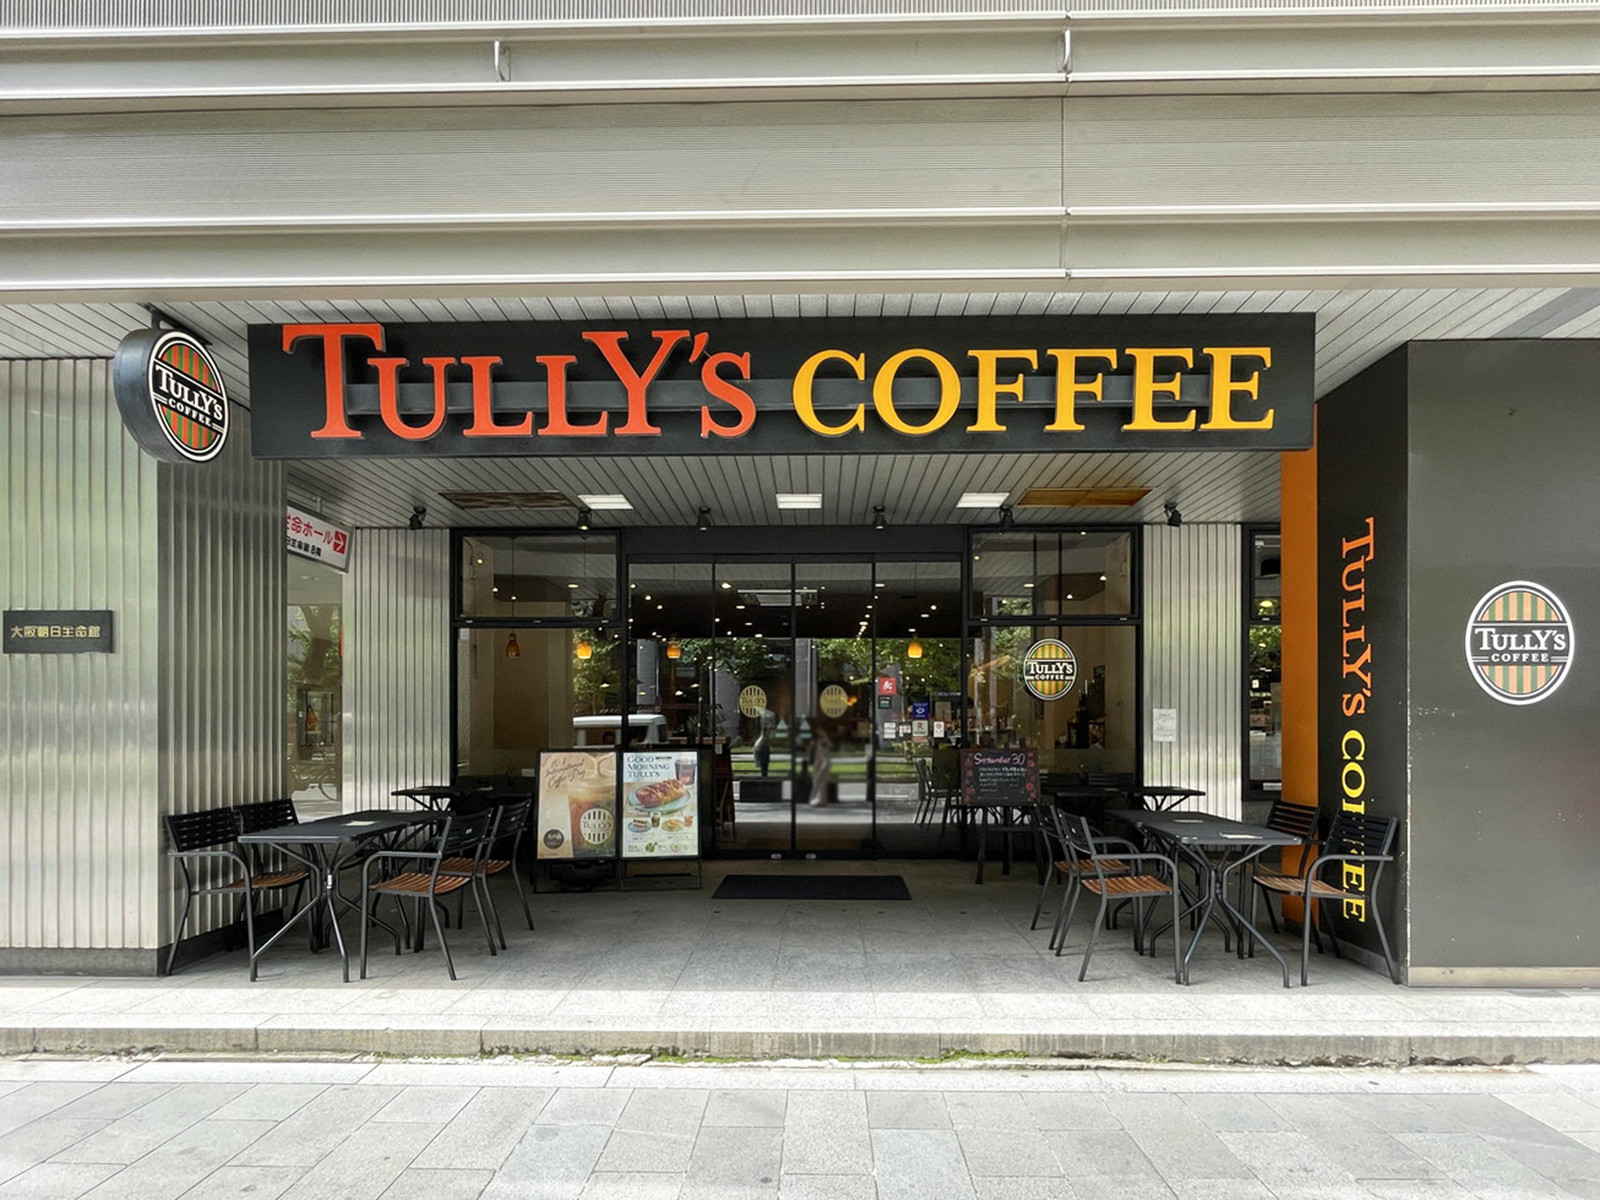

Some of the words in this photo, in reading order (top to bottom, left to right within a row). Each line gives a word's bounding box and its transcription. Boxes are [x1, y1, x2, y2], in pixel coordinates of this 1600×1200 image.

[282, 323, 757, 440] TULLY'S
[793, 346, 1275, 436] COFFEE
[155, 364, 223, 421] TULLY'S
[168, 399, 213, 427] COFFEE
[1341, 516, 1375, 717] TULLY'S
[10, 625, 101, 639] 大阪朝日生命館
[1474, 627, 1567, 651] TULLY'S
[1490, 653, 1549, 662] COFFEE
[1026, 661, 1074, 675] TULLY'S
[627, 755, 655, 763] GOOD
[1011, 752, 1026, 766] 30
